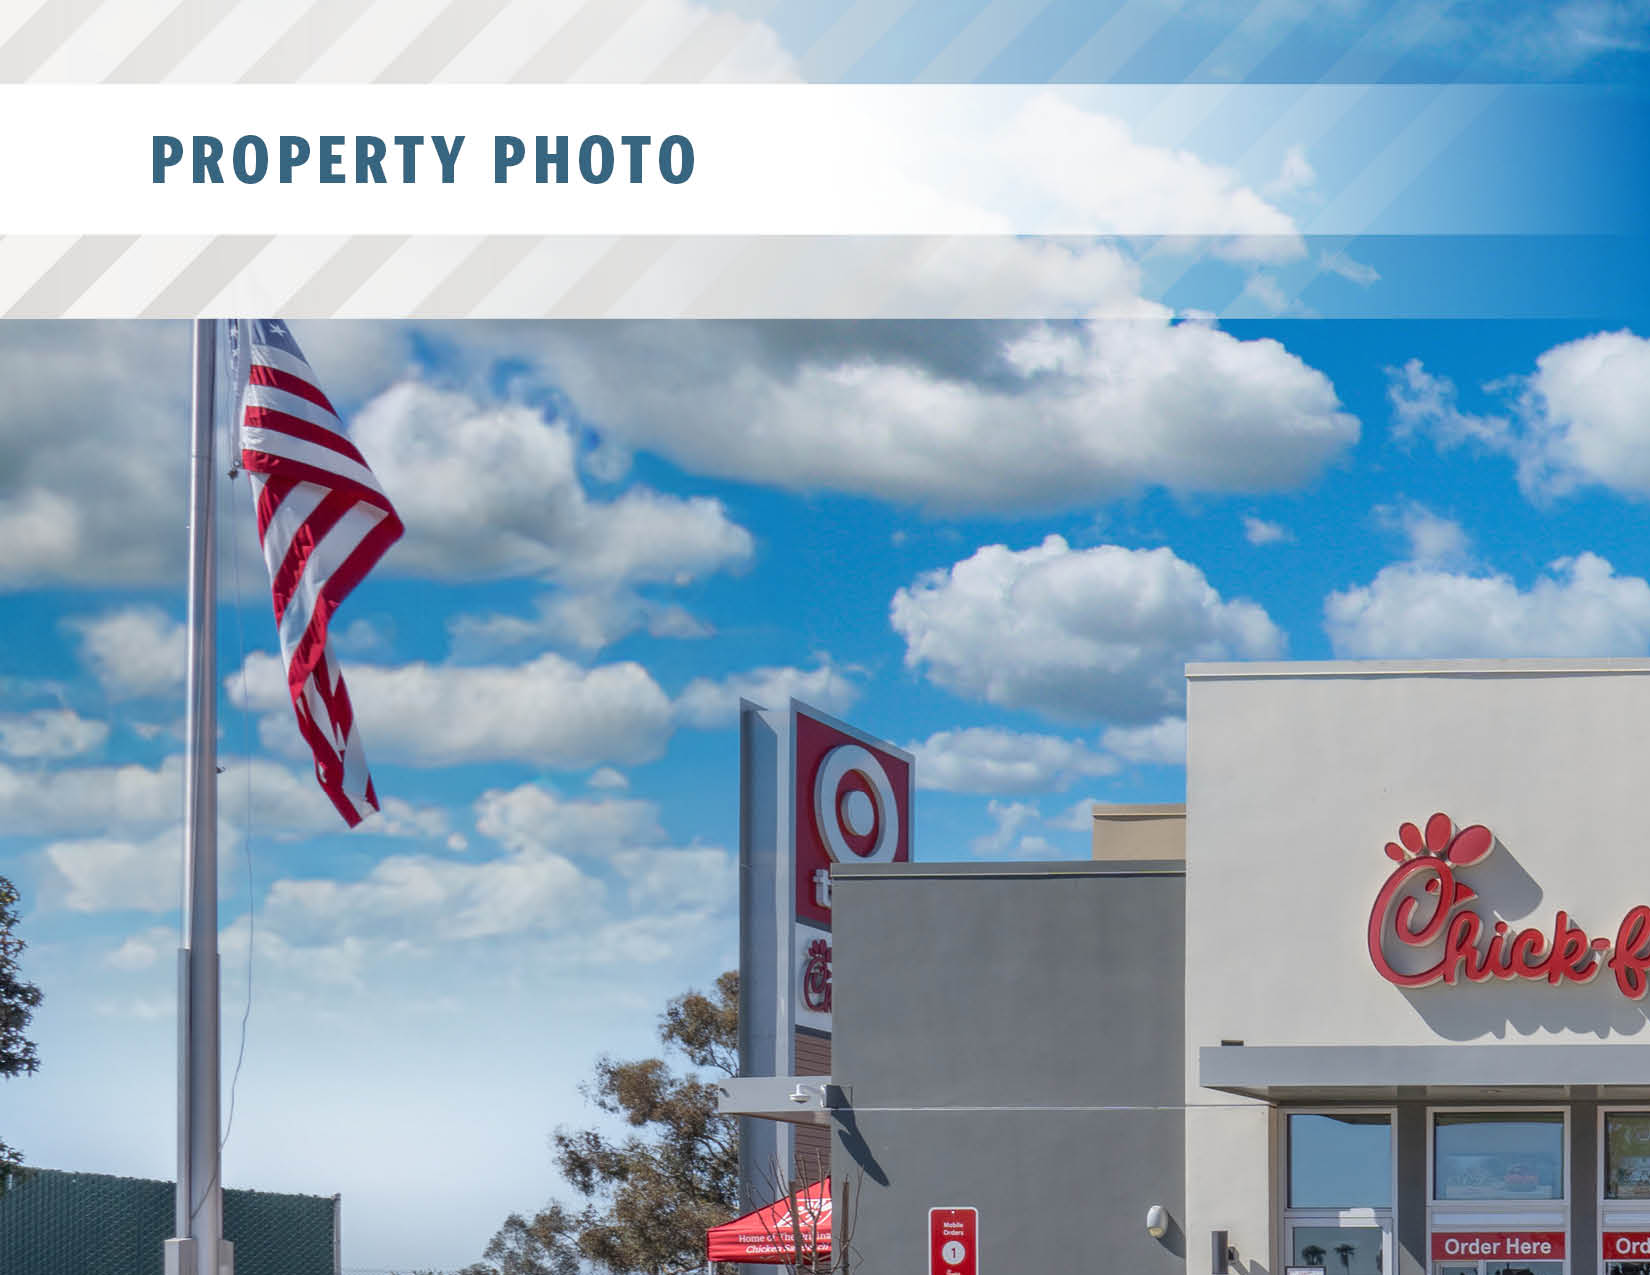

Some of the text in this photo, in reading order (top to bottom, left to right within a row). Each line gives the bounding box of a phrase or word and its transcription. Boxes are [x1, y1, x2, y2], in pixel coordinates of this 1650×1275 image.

[739, 1234, 766, 1243] Home
[745, 1243, 781, 1254] Chicken
[1445, 1238, 1552, 1255] Order Here
[951, 1248, 956, 1258] 1
